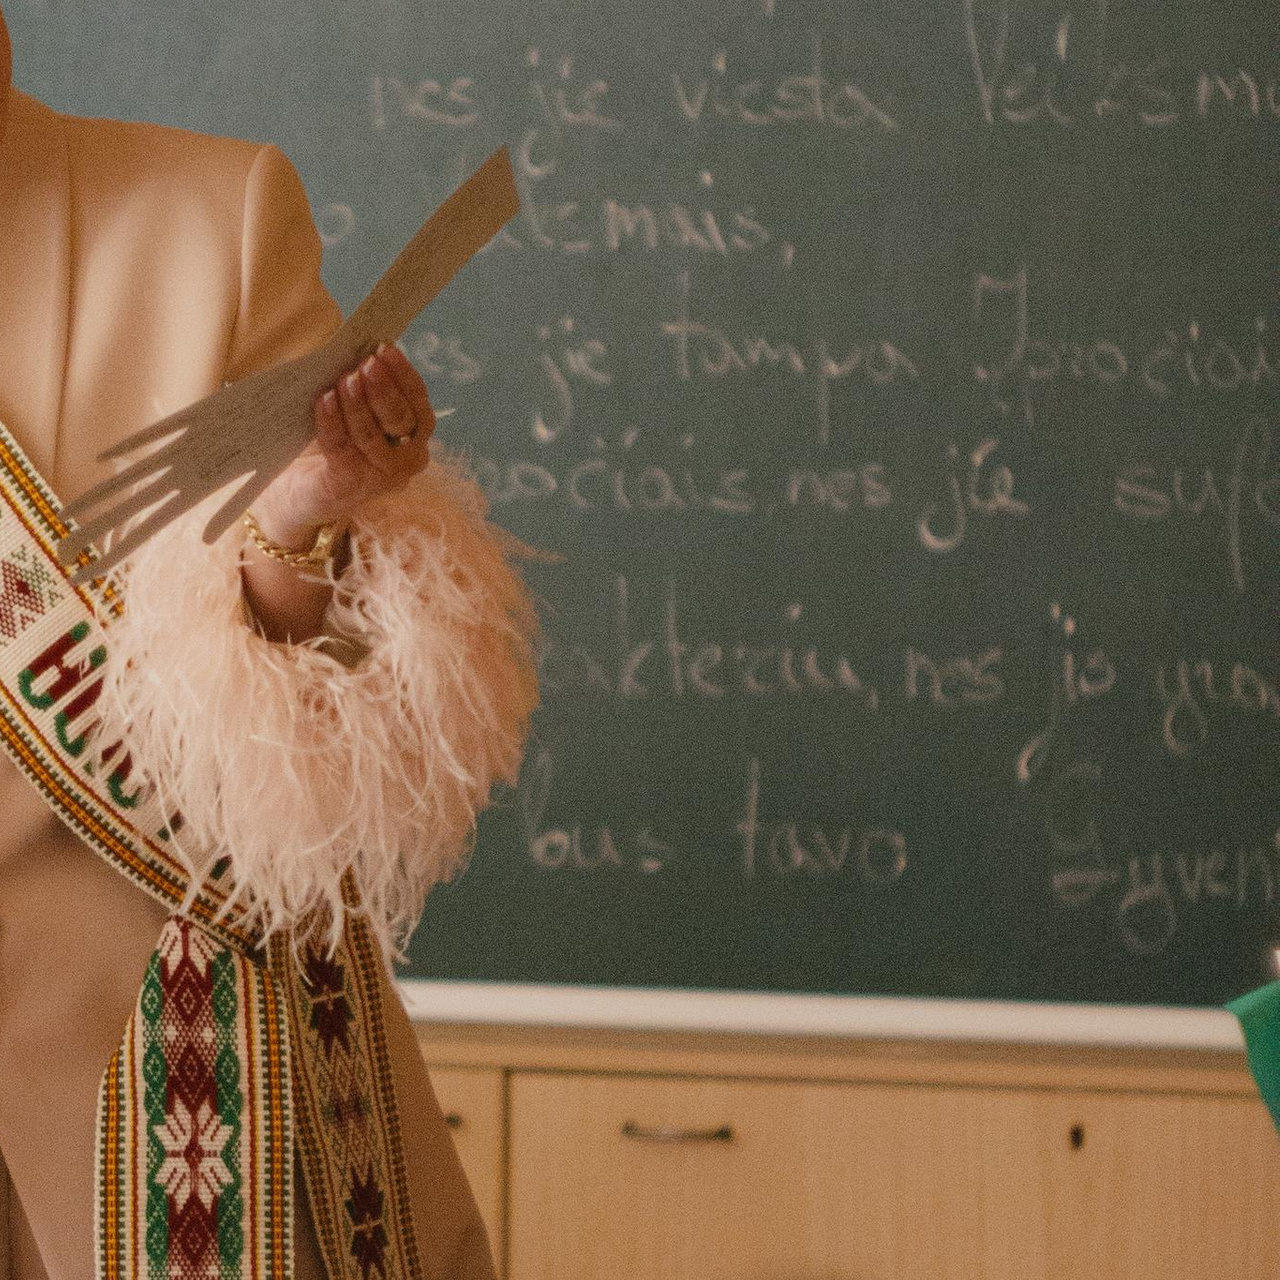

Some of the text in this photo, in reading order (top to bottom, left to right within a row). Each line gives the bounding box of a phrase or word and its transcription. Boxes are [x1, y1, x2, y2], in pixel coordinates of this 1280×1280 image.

[368, 70, 480, 130] nes
[411, 331, 481, 382] es
[662, 271, 919, 446] tampa
[788, 463, 892, 512] nes
[739, 755, 908, 884] tavo
